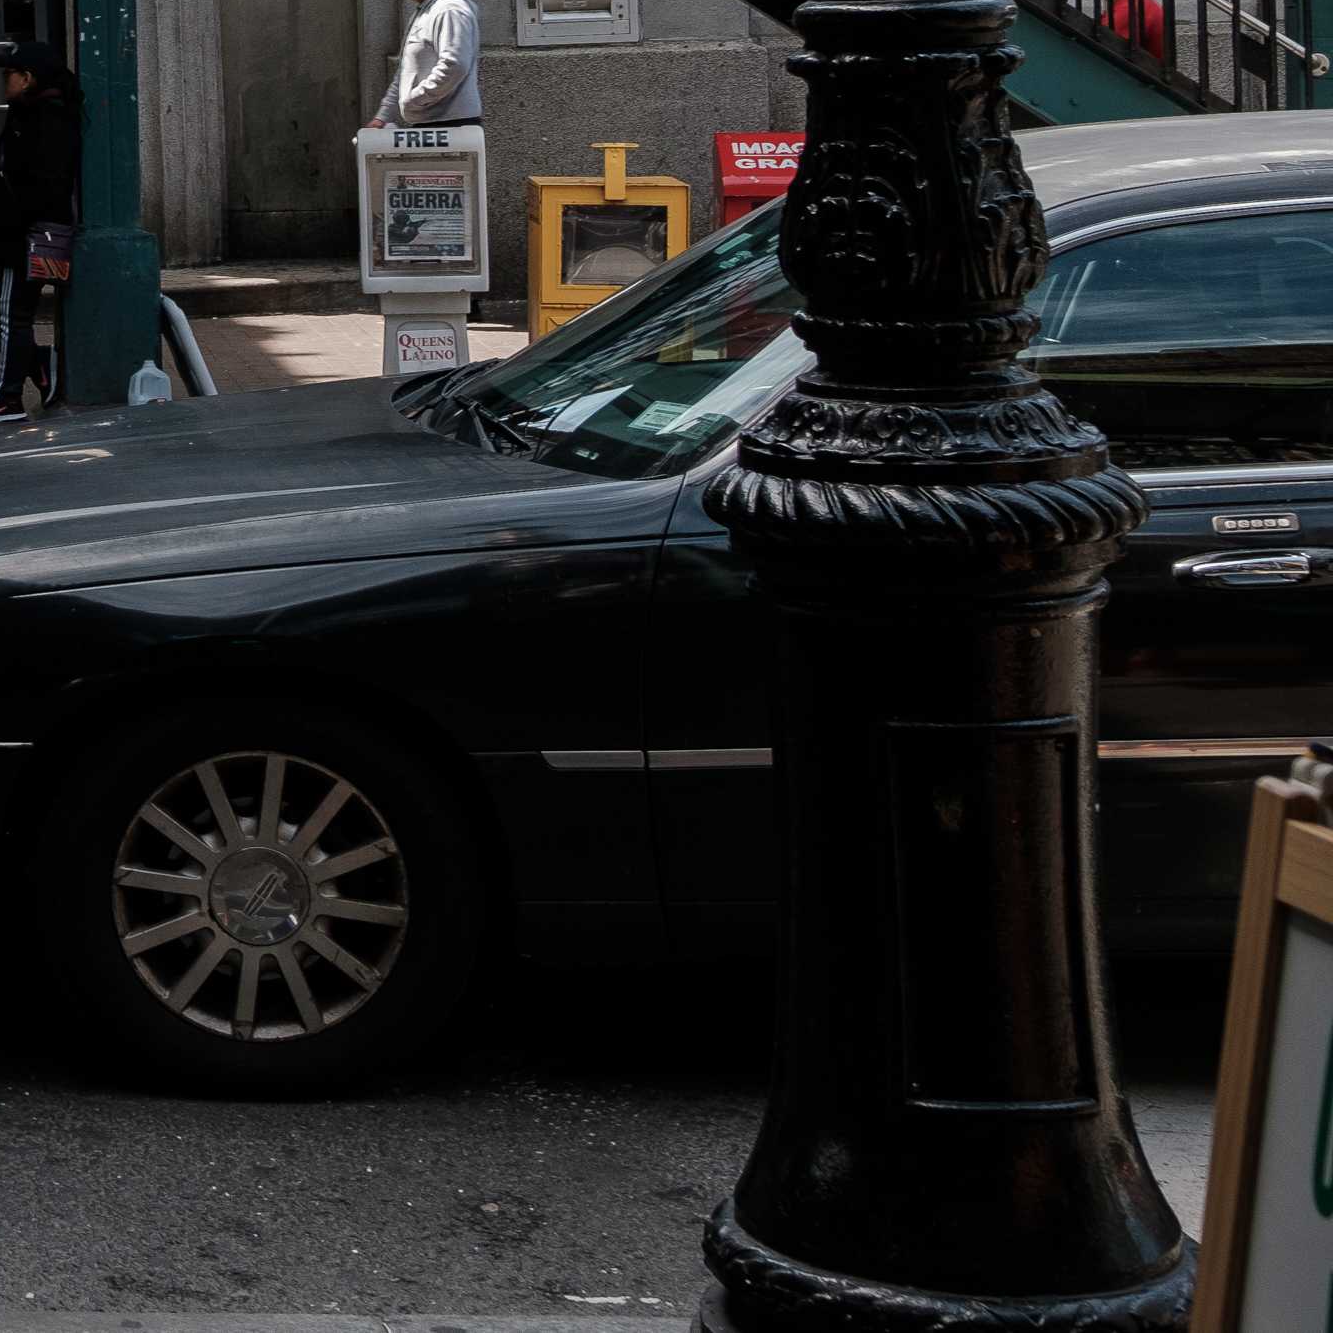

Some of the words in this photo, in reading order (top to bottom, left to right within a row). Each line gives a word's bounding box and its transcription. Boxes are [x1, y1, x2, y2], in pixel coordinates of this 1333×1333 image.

[394, 130, 449, 148] FREE
[731, 141, 806, 156] IMPAC
[734, 158, 798, 170] GRA
[389, 191, 463, 210] GUERRA
[398, 333, 454, 352] QUEENS
[401, 347, 455, 362] LATINO
